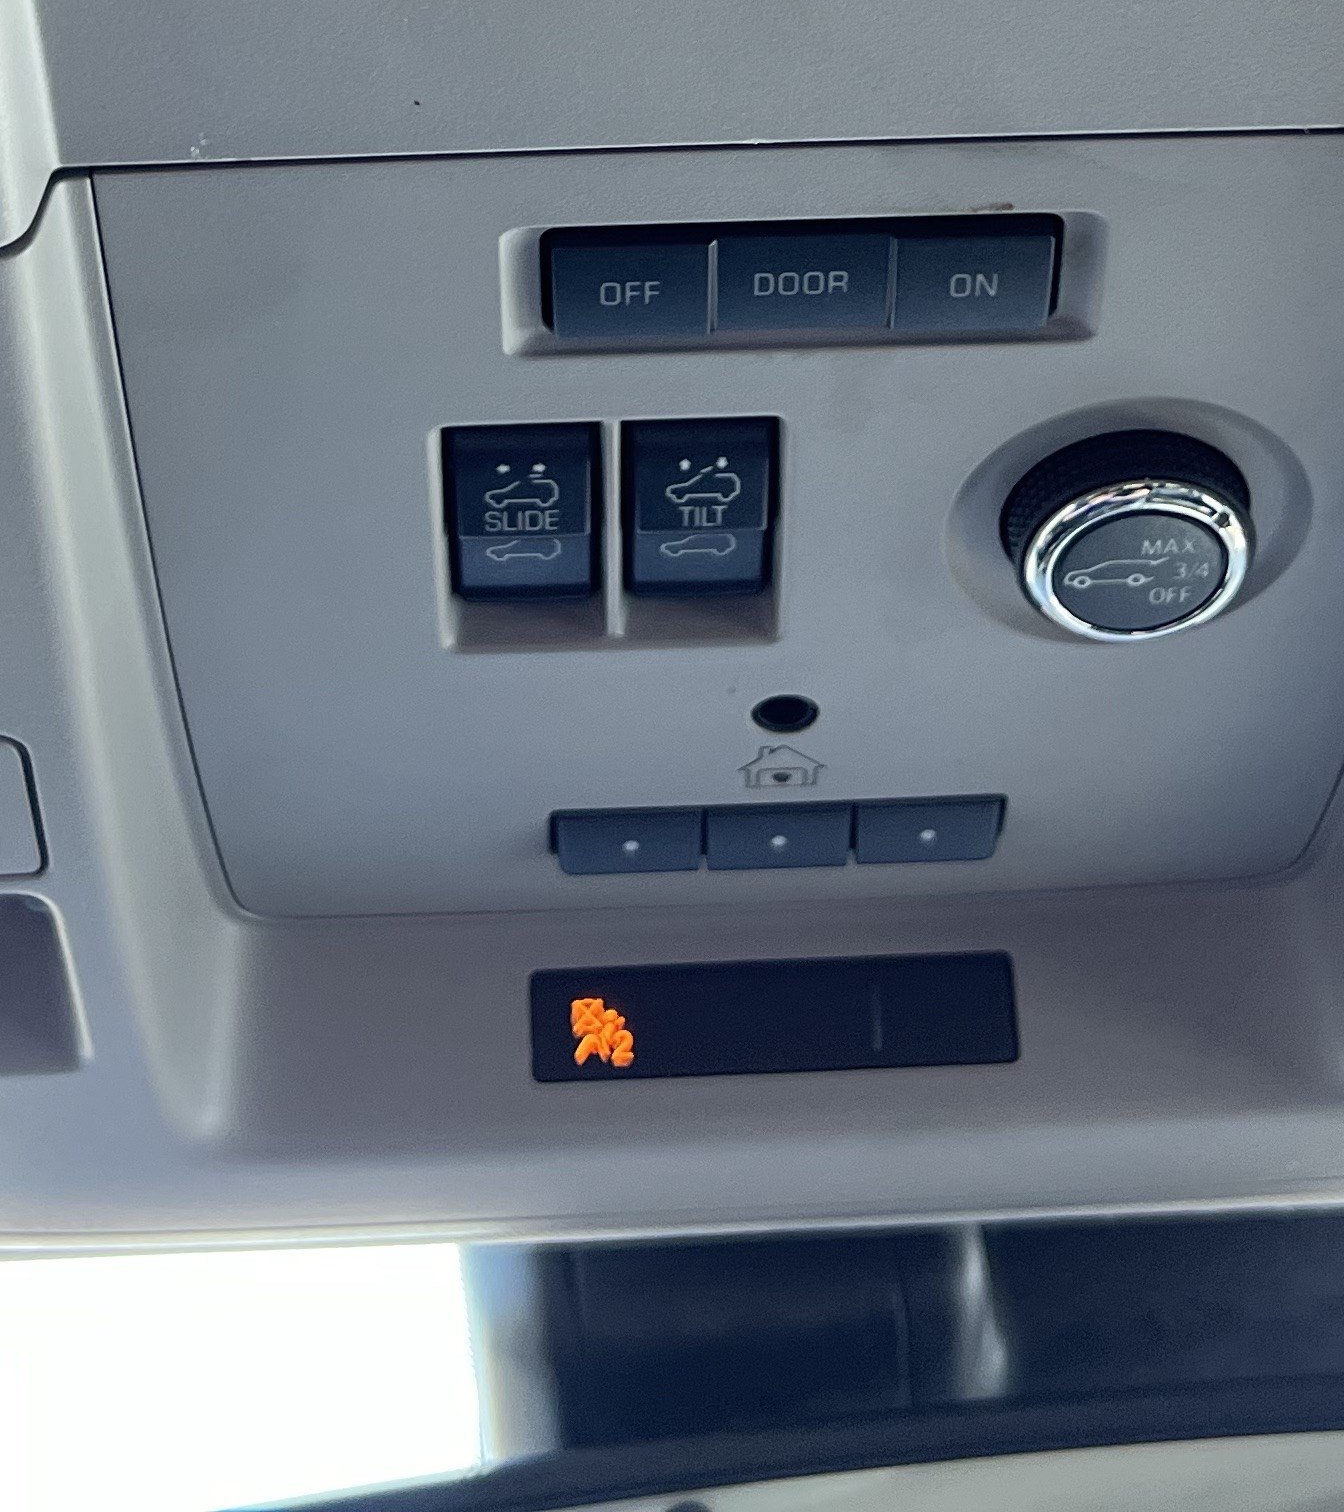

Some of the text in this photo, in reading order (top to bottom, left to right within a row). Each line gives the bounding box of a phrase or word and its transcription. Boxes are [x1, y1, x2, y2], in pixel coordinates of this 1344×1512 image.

[599, 280, 661, 306] OFF
[753, 270, 849, 296] DOOR
[949, 273, 998, 298] ON
[484, 509, 559, 532] SLIDE
[679, 505, 728, 527] TILT
[1141, 538, 1197, 556] MAX
[1173, 562, 1210, 580] 3/4
[1149, 586, 1192, 604] OFF
